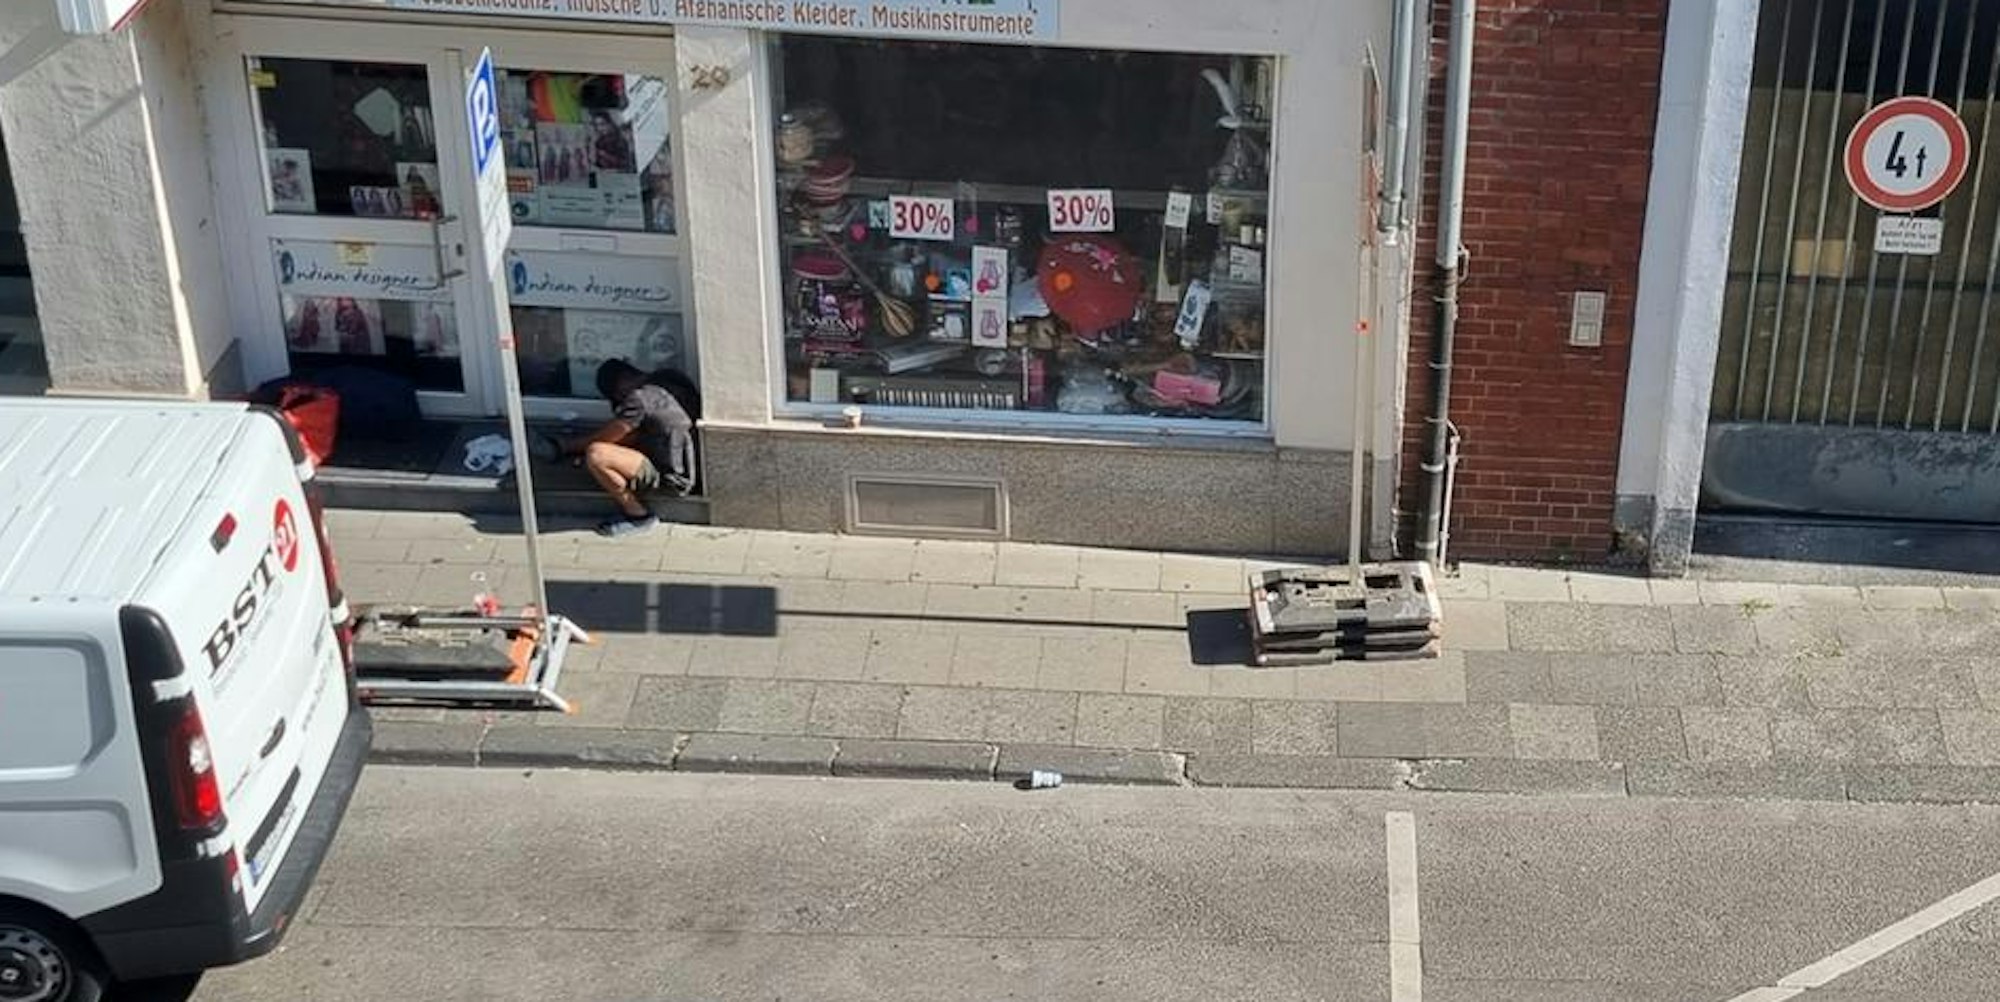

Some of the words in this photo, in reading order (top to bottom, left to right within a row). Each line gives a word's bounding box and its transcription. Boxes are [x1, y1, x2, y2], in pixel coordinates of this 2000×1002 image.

[872, 5, 1033, 35] Musikinstrumente
[1885, 131, 1907, 179] 4
[1915, 145, 1927, 179] t
[893, 201, 951, 235] 30%
[1051, 195, 1111, 227] 30%
[201, 543, 275, 681] BST
